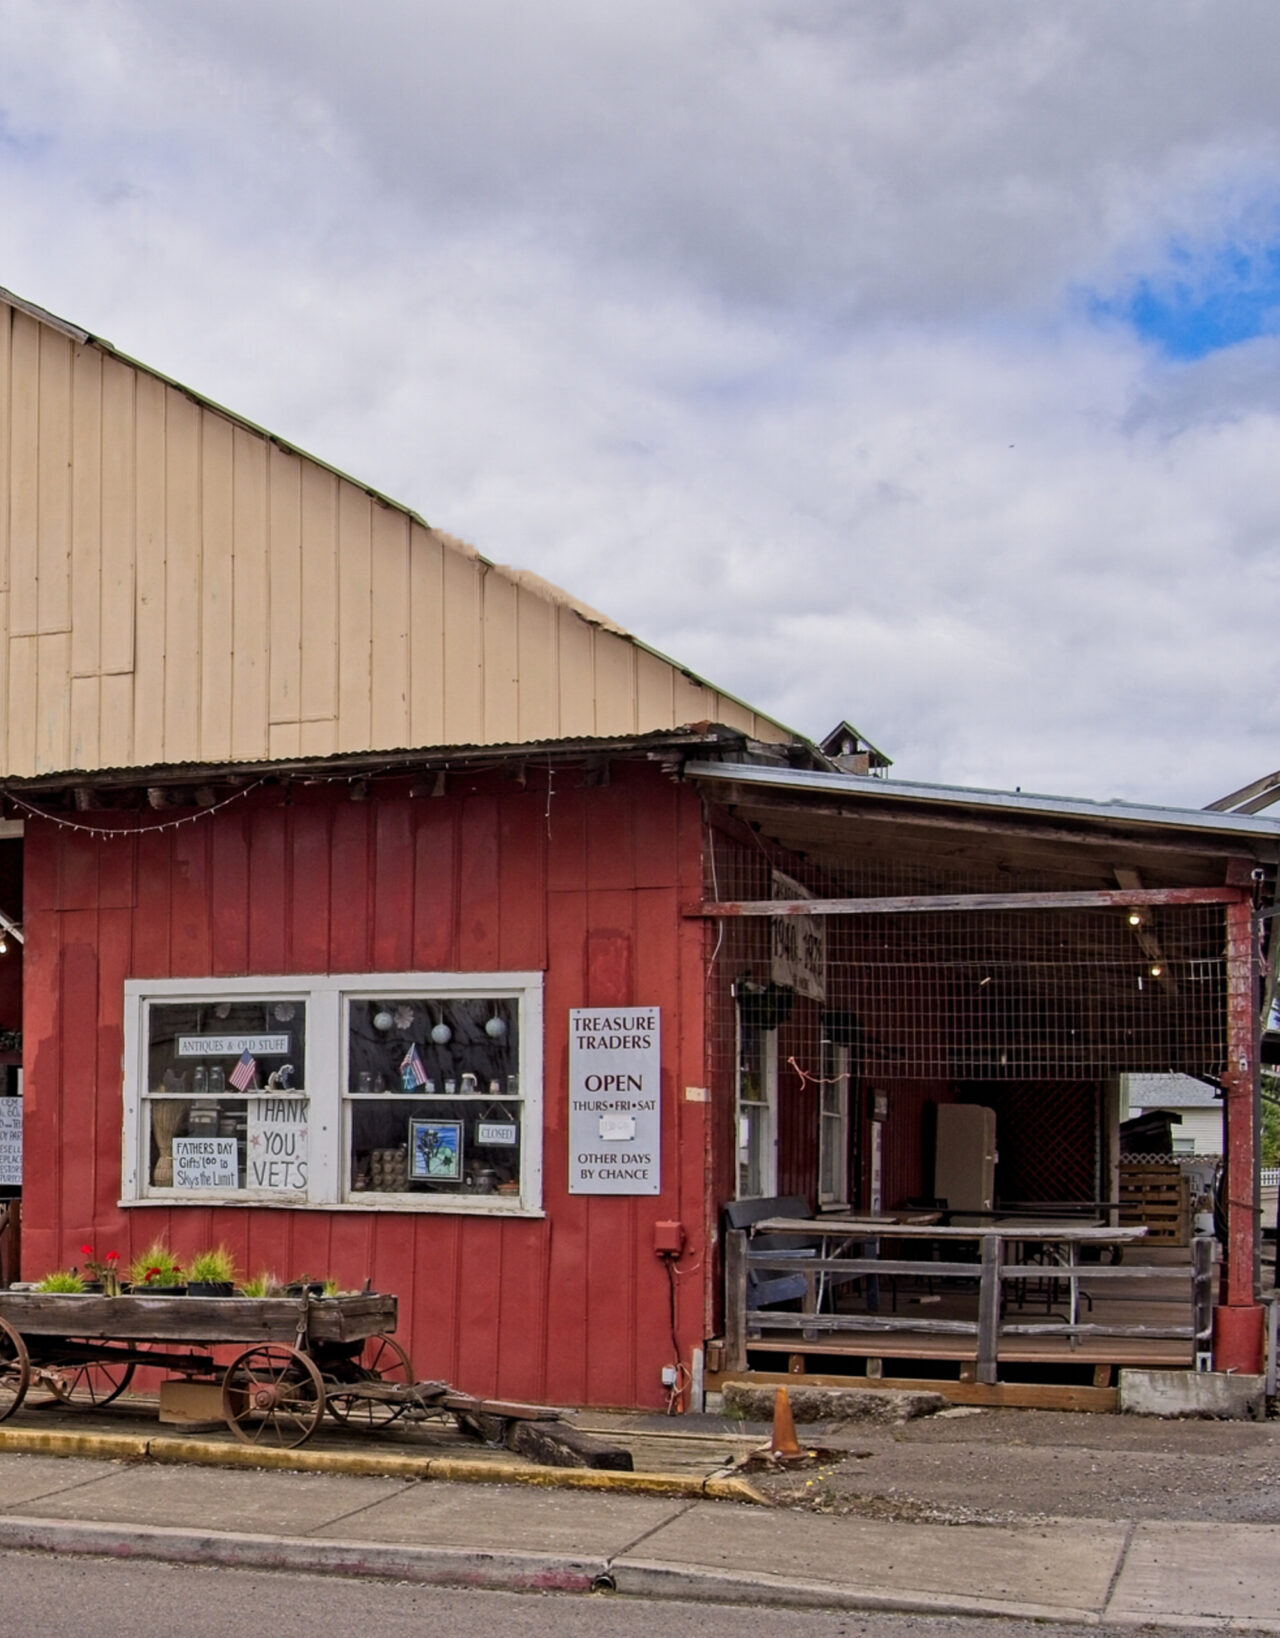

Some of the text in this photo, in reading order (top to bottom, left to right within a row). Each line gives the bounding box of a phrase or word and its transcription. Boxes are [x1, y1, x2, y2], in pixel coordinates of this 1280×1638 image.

[573, 1016, 656, 1031] TREASURE
[182, 1040, 224, 1053] ANTIQUES
[226, 1041, 234, 1051] &
[259, 1038, 285, 1051] STUFF
[577, 1035, 651, 1050] TRADERS
[584, 1074, 643, 1092] OPEN
[255, 1099, 308, 1123] THANK
[177, 1142, 233, 1155] FATHERS DAY
[263, 1131, 296, 1156] YOU
[577, 1153, 651, 1165] OTHER DAYS
[253, 1161, 308, 1189] VETS
[580, 1168, 649, 1180] BY CHANCE
